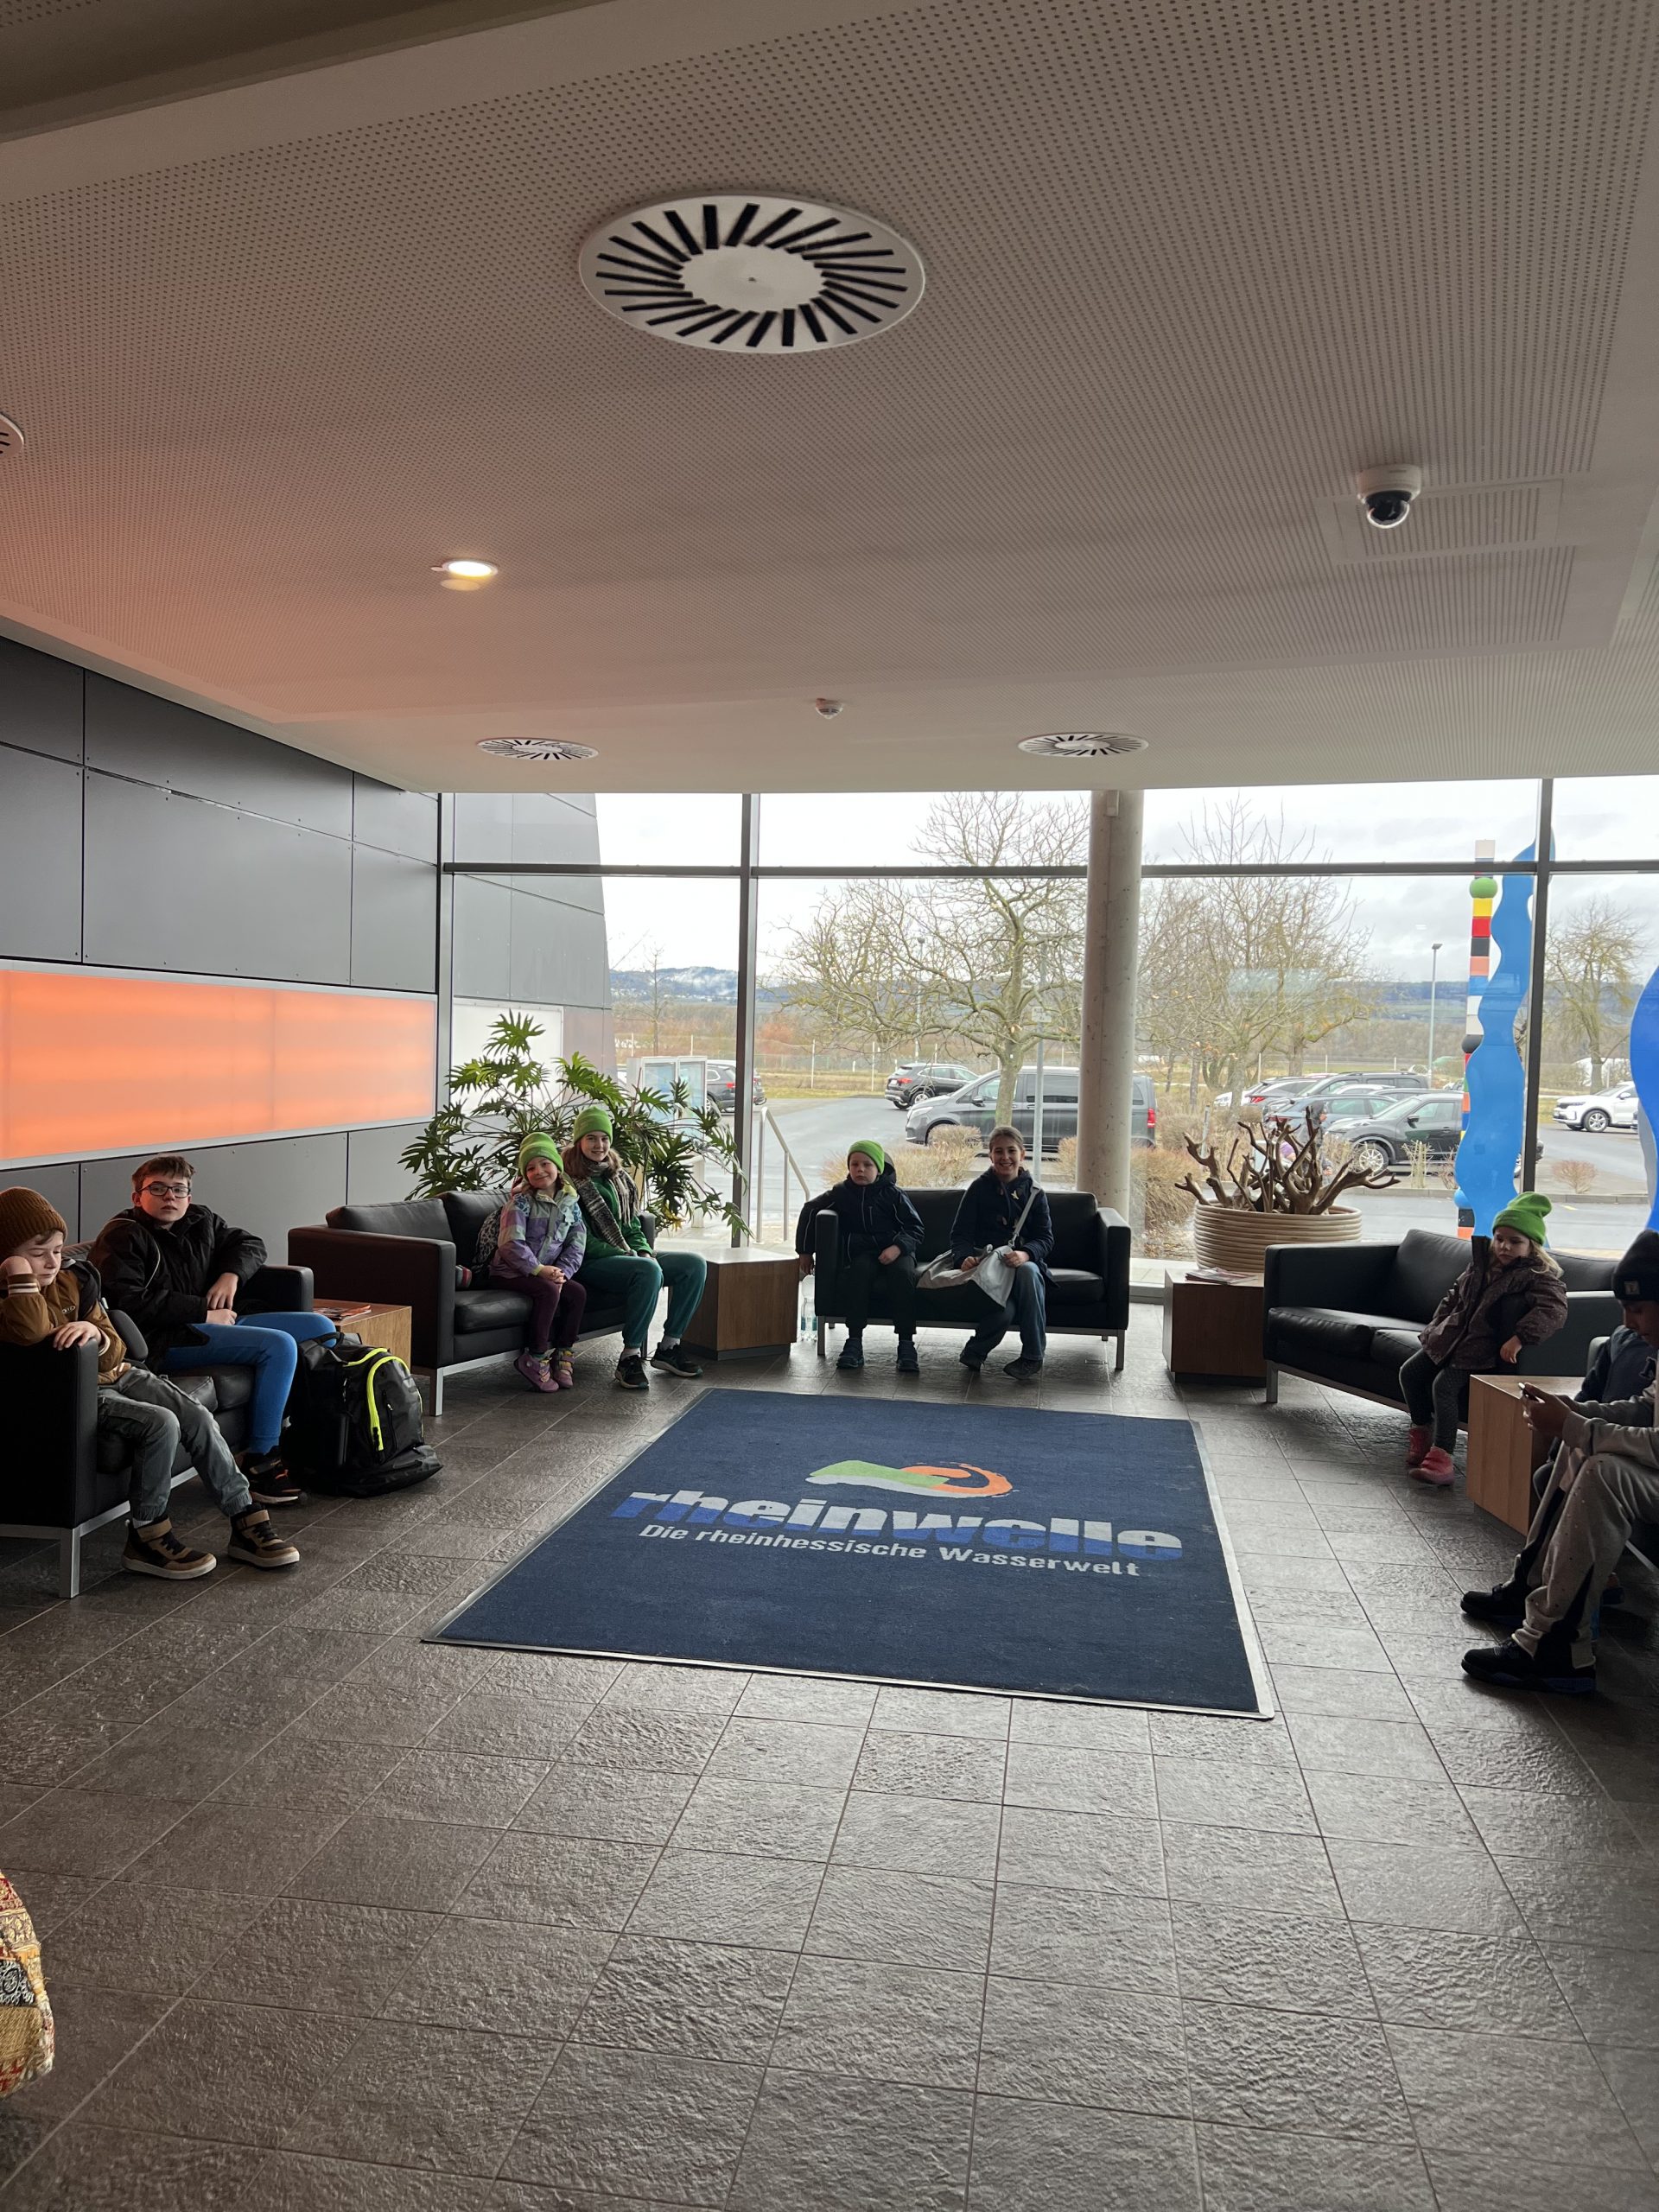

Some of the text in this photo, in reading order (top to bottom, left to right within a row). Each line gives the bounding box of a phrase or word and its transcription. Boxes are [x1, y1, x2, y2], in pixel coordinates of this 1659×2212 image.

[609, 1490, 1183, 1560] rheinwelle
[639, 1523, 1140, 1576] Die rheinhessische Wasserwelt
